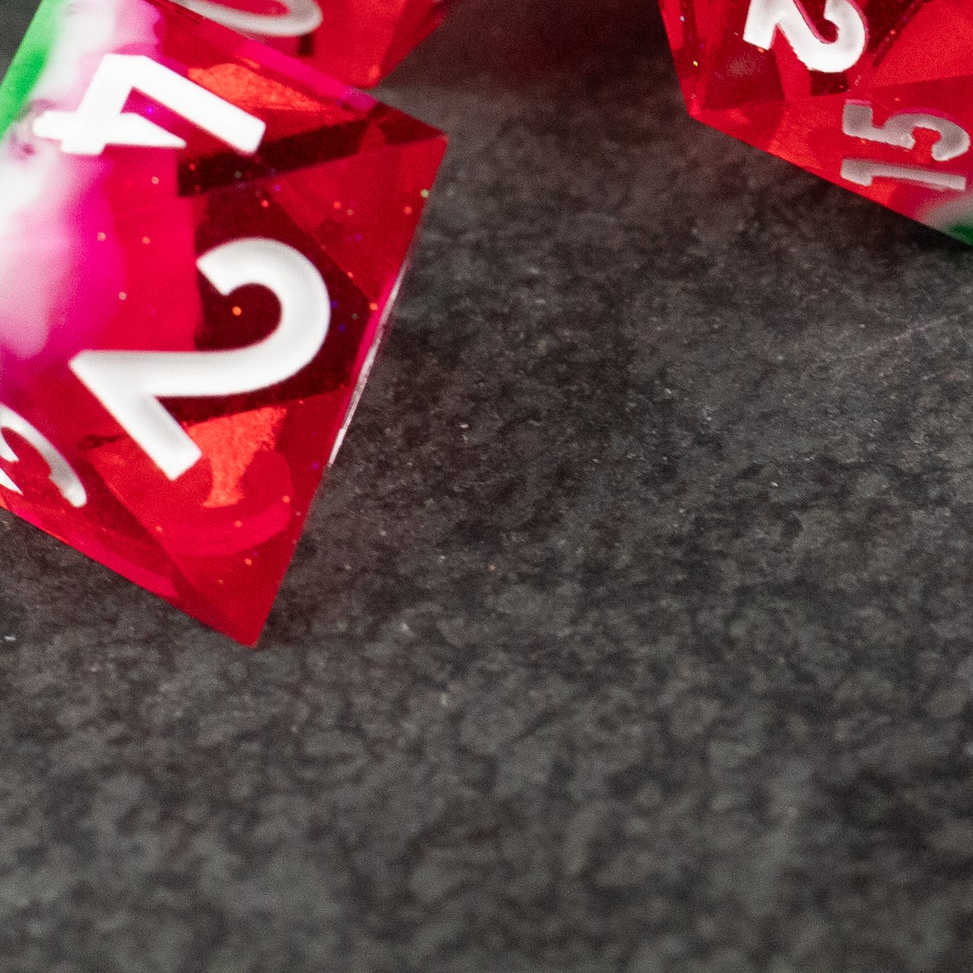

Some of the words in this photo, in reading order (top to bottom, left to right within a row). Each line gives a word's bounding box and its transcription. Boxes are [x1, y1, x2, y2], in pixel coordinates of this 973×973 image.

[33, 53, 267, 156] 4
[840, 99, 971, 191] 15
[68, 237, 331, 480] 2
